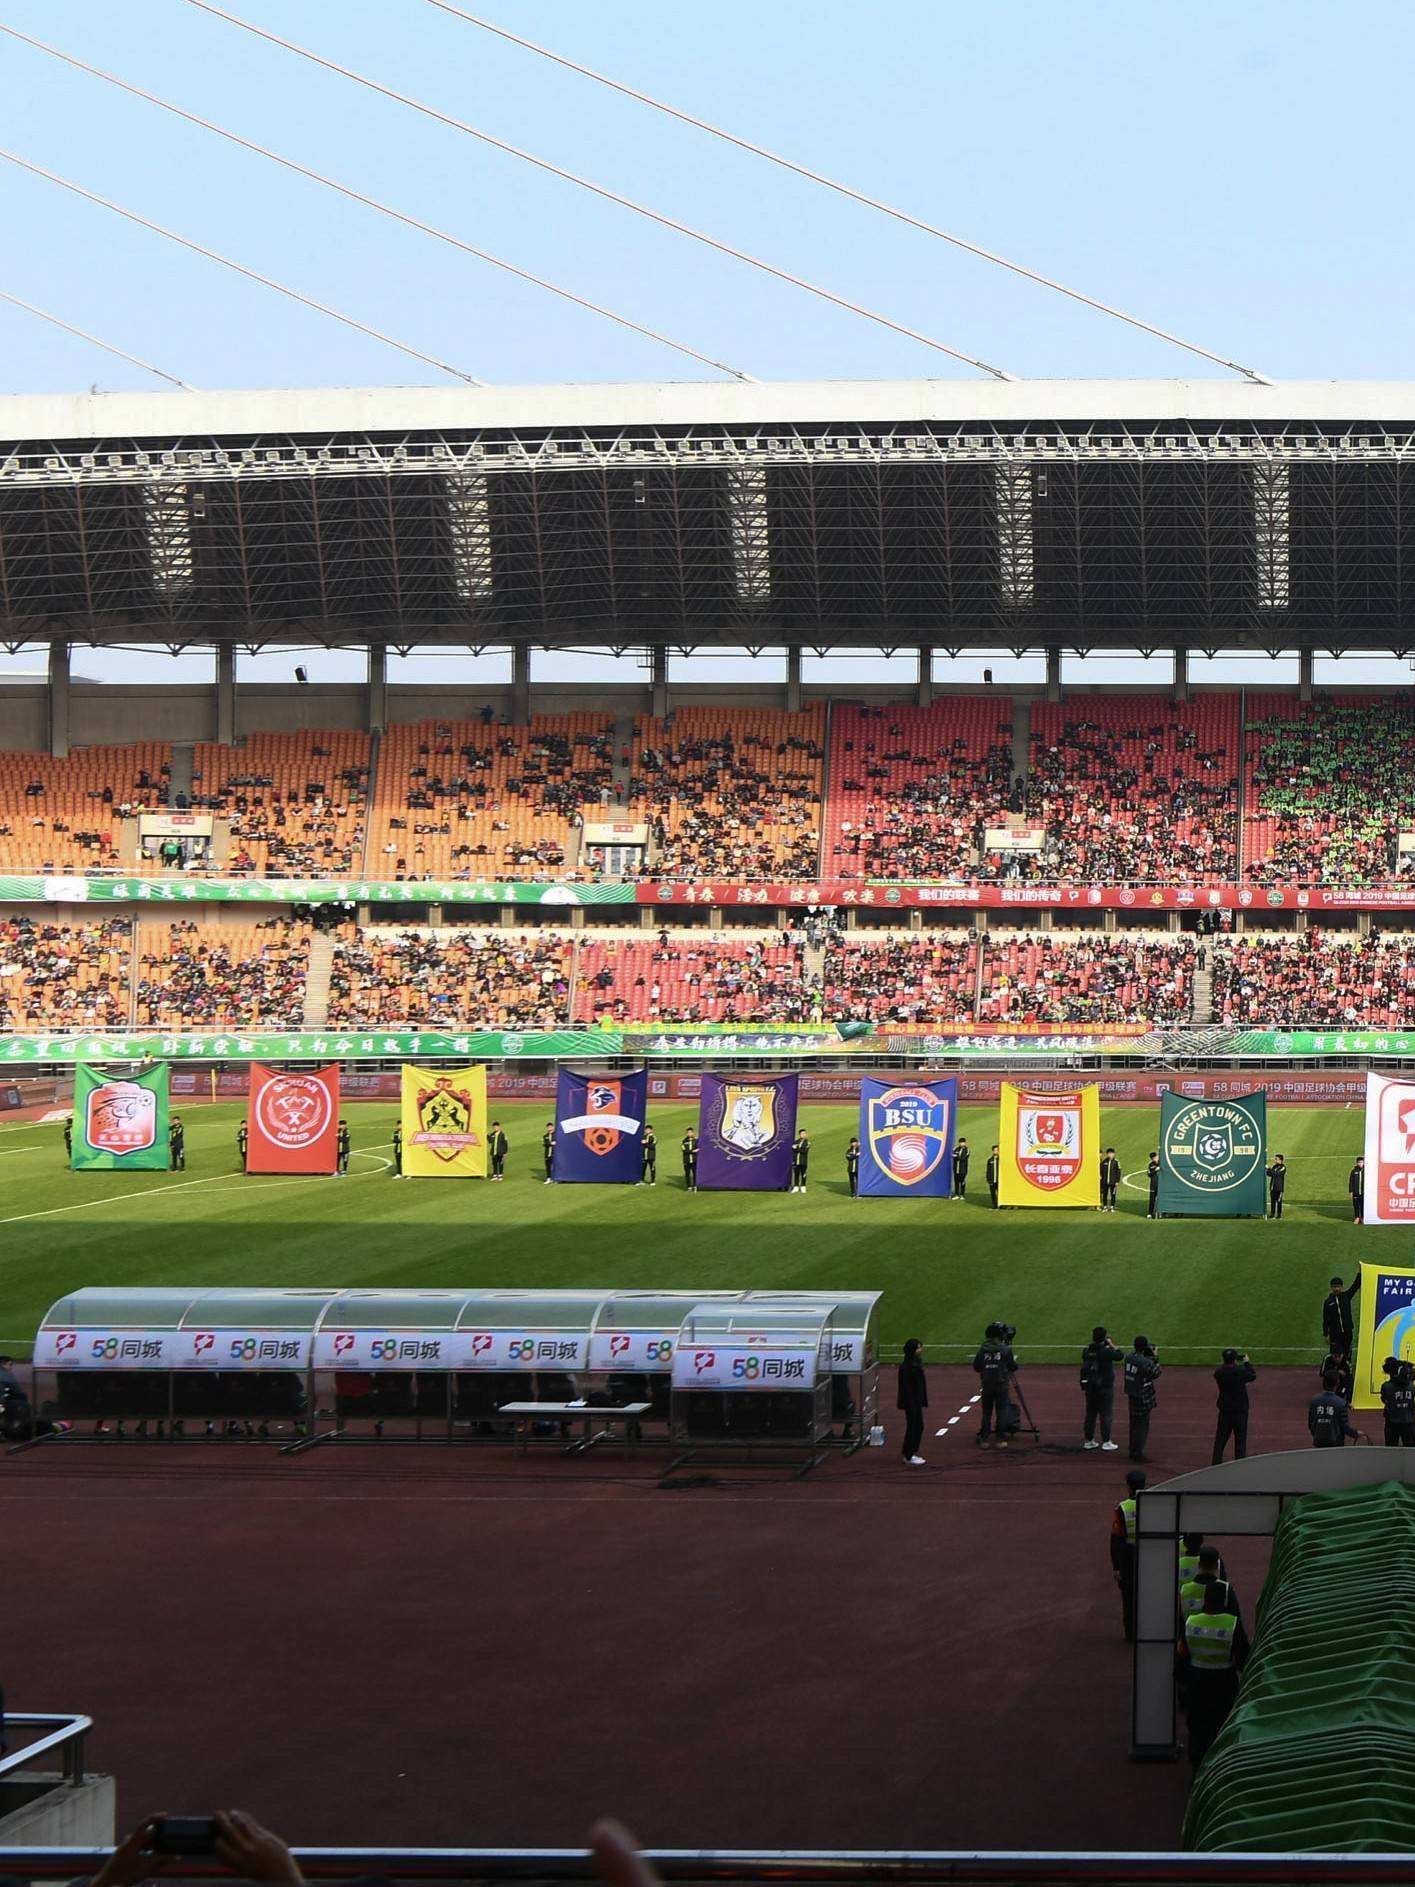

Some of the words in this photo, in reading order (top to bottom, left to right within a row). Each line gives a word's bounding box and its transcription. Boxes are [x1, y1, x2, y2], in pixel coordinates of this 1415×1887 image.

[962, 1080, 976, 1091] 58
[1213, 1082, 1227, 1092] 58
[884, 1108, 934, 1127] BSU
[1173, 1106, 1244, 1141] GREENTOWN
[1238, 1123, 1254, 1141] FC
[277, 1131, 310, 1143] UNITED
[1189, 1169, 1236, 1184] ZHEJIANG
[1384, 1278, 1401, 1287] MY
[1383, 1287, 1413, 1296] FAIR
